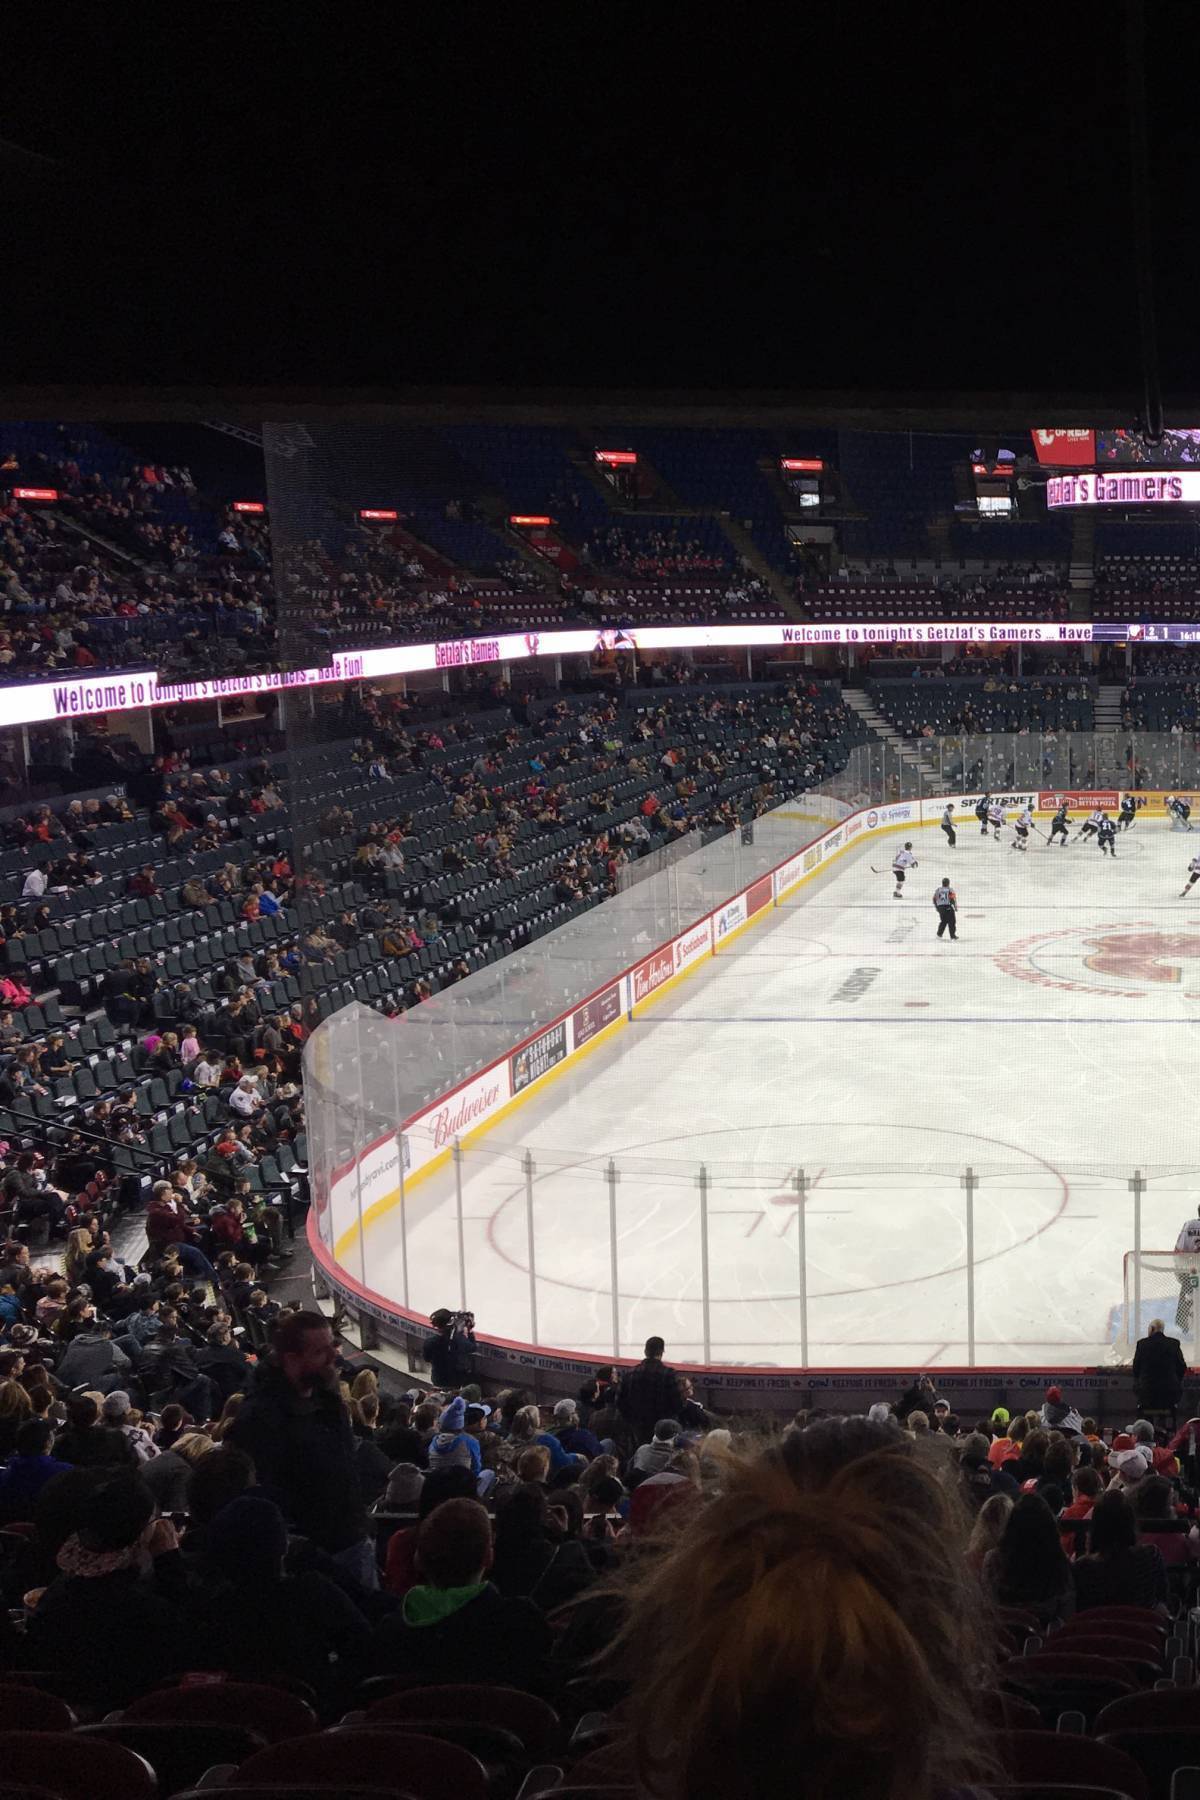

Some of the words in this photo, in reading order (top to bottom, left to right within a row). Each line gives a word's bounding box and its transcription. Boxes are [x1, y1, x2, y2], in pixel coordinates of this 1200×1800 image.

[1094, 475, 1183, 501] Gamers
[782, 627, 842, 642] Welcome
[846, 627, 859, 641] to
[862, 627, 923, 643] tonight's
[927, 626, 985, 641] Getzlaf's
[989, 626, 1042, 641] Gamers
[1058, 626, 1092, 640] Have
[471, 639, 500, 664] Gamers
[53, 681, 127, 714] Welcome
[131, 680, 144, 704] to
[343, 654, 364, 678] Fun!
[1102, 822, 1114, 831] 21
[428, 1083, 500, 1149] Budweiser
